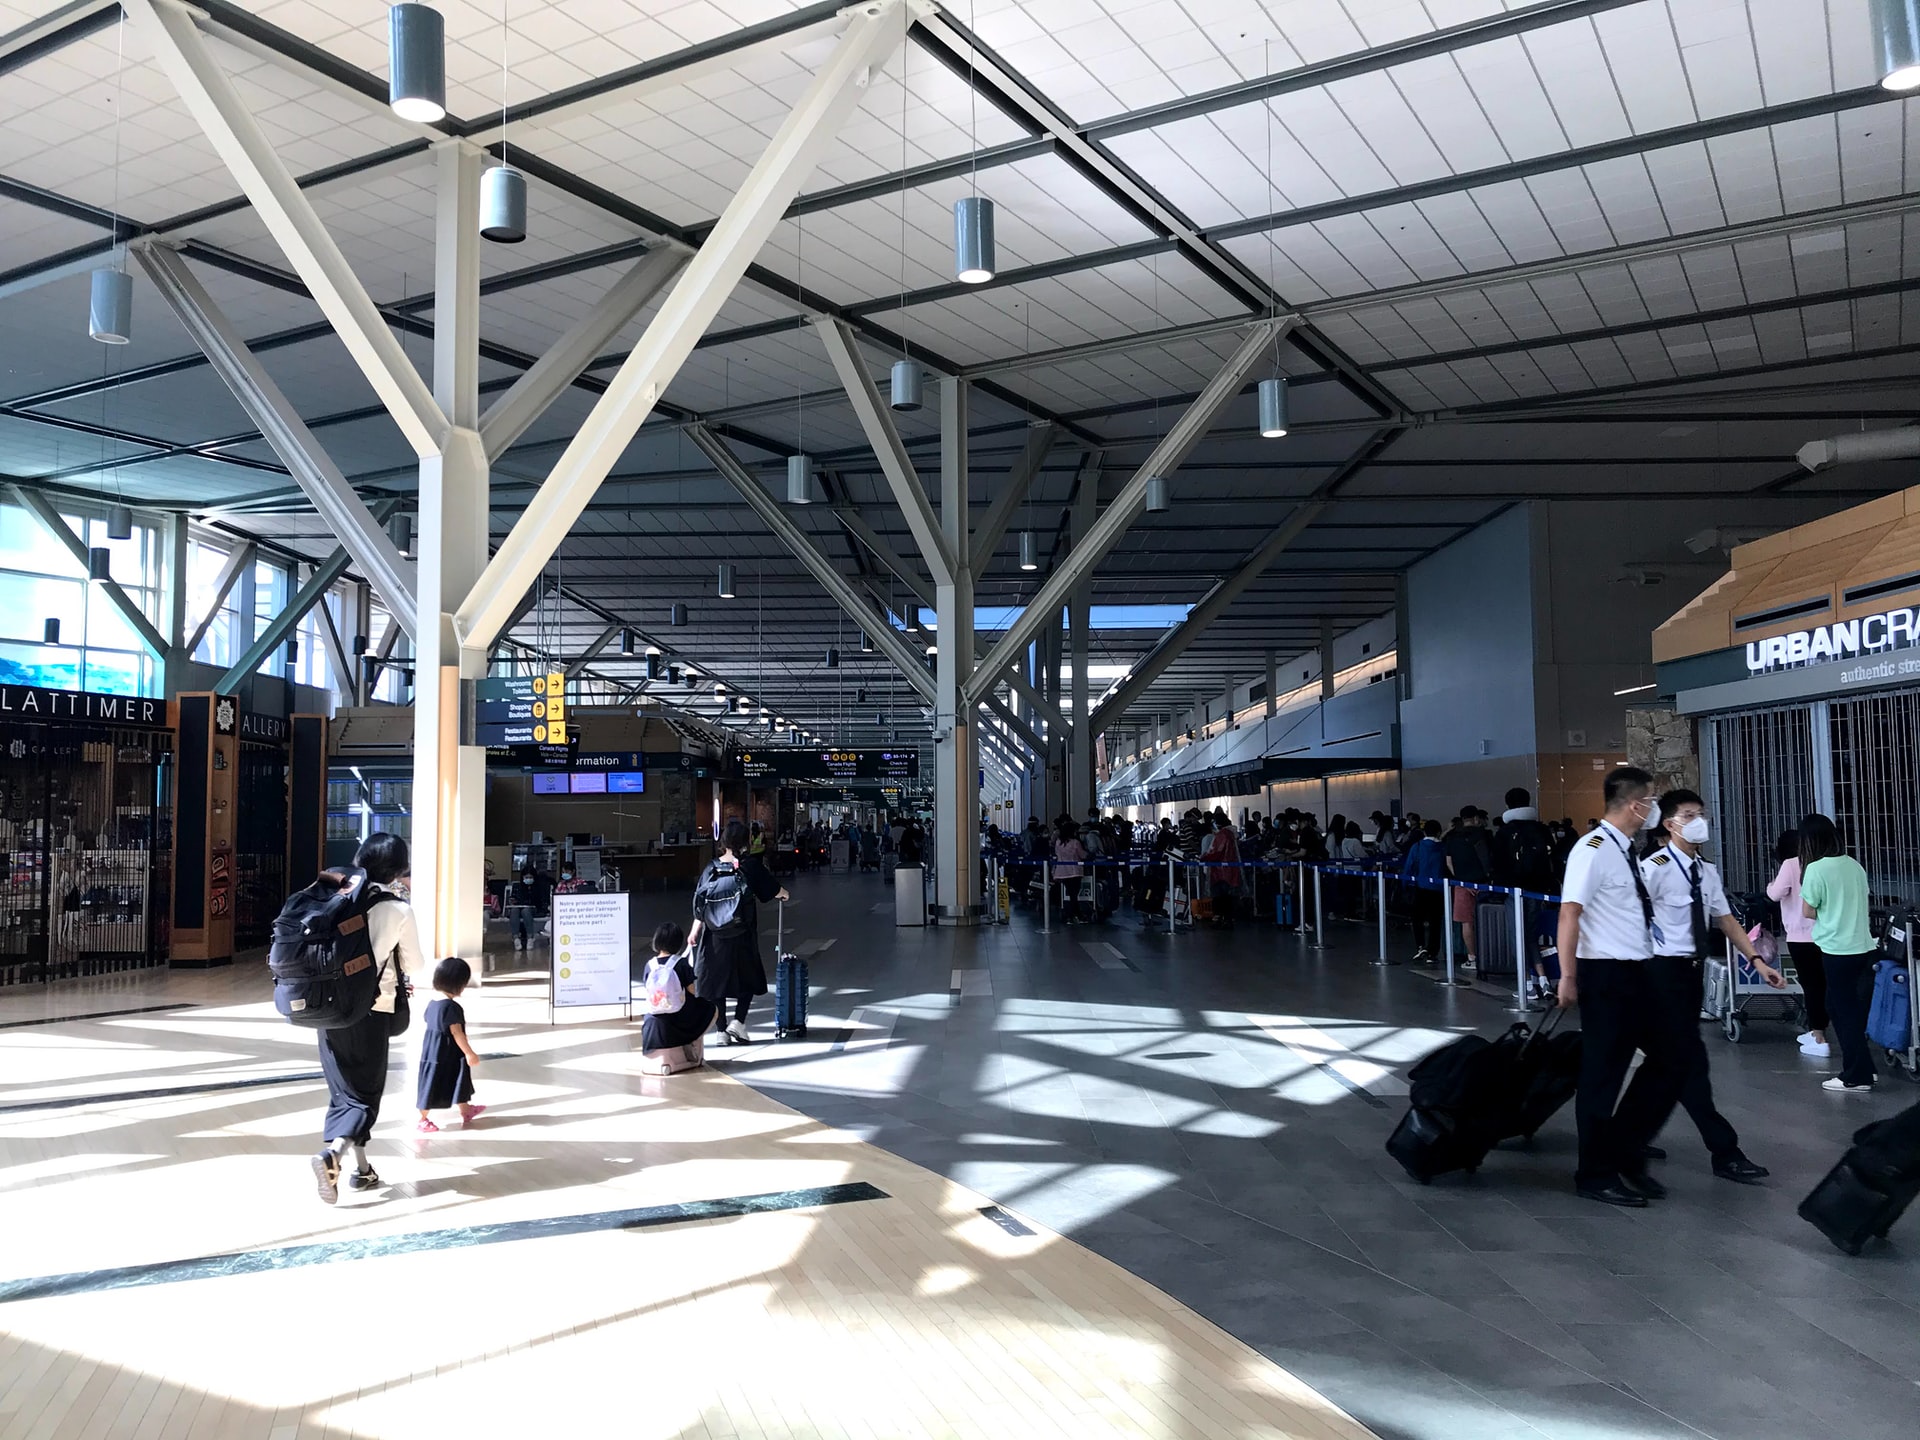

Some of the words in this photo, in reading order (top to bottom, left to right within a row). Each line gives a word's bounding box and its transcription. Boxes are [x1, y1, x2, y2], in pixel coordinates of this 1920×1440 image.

[1746, 607, 1920, 671] URBANCR
[1840, 661, 1895, 684] authentic
[2, 688, 154, 721] LATTIMER
[1739, 967, 1800, 986] YR
